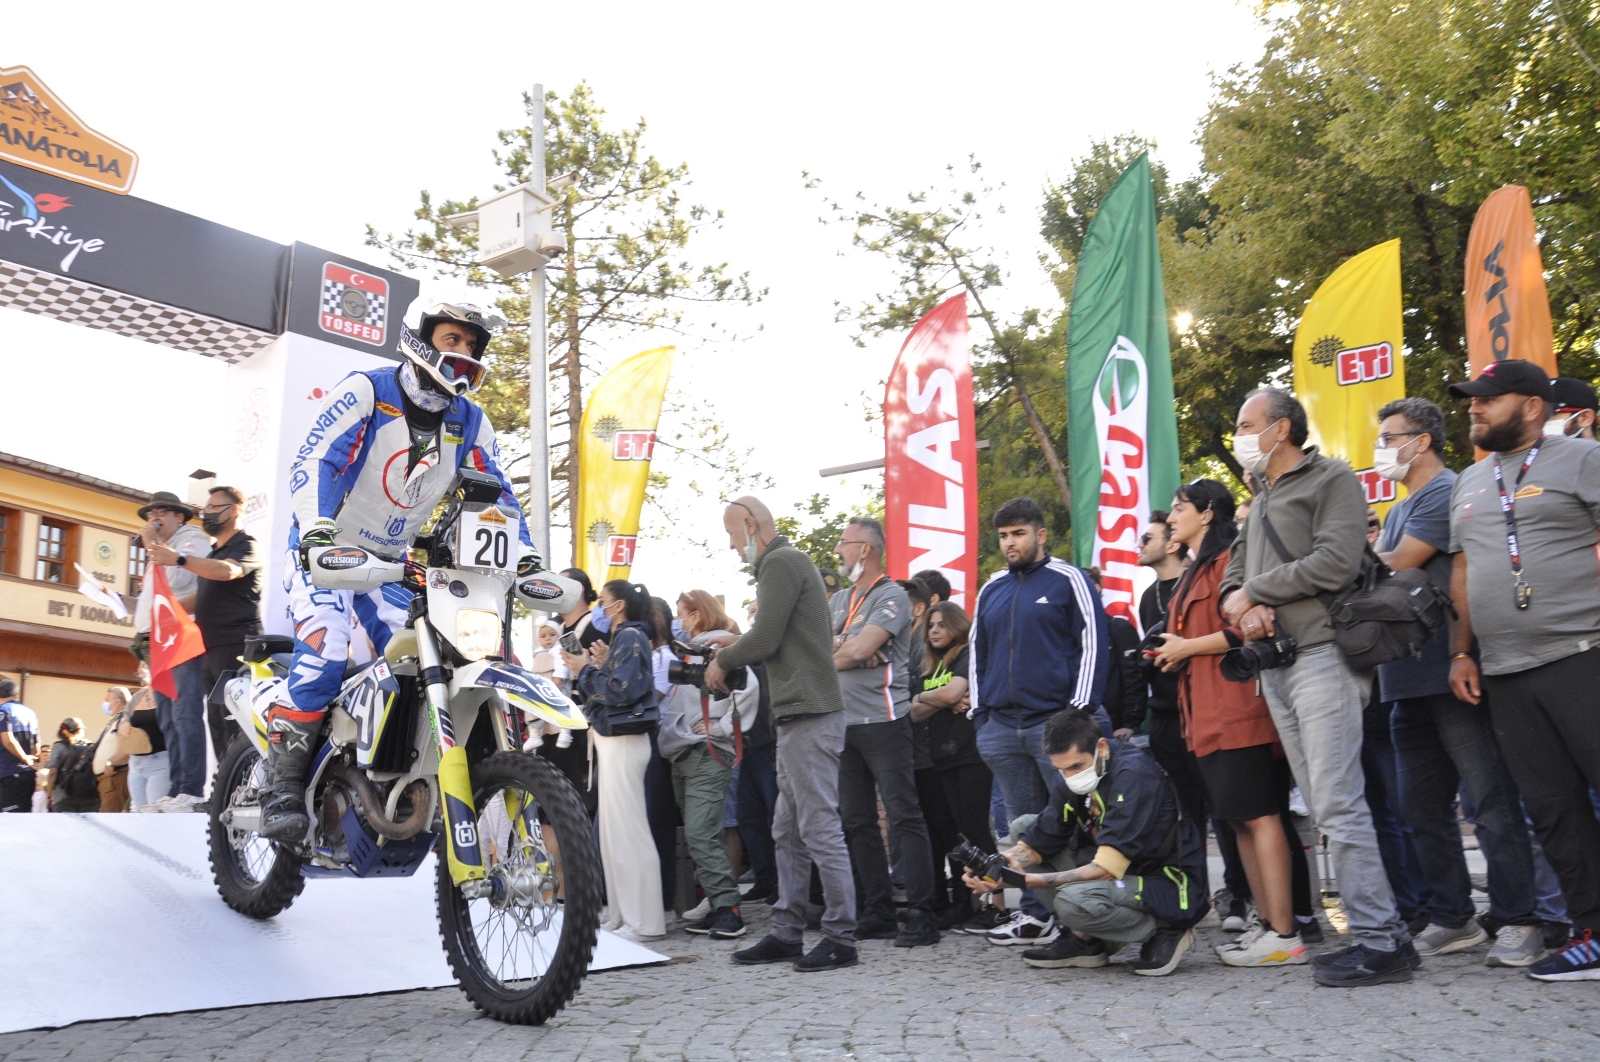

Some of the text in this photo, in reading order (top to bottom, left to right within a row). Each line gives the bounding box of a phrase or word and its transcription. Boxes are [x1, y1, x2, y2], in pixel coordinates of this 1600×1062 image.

[0, 201, 105, 272] rkiye
[324, 315, 381, 341] TOSFED
[907, 368, 966, 608] NLAS
[474, 527, 509, 569] 20
[48, 599, 75, 618] BEY
[495, 680, 528, 693] DUNLOP
